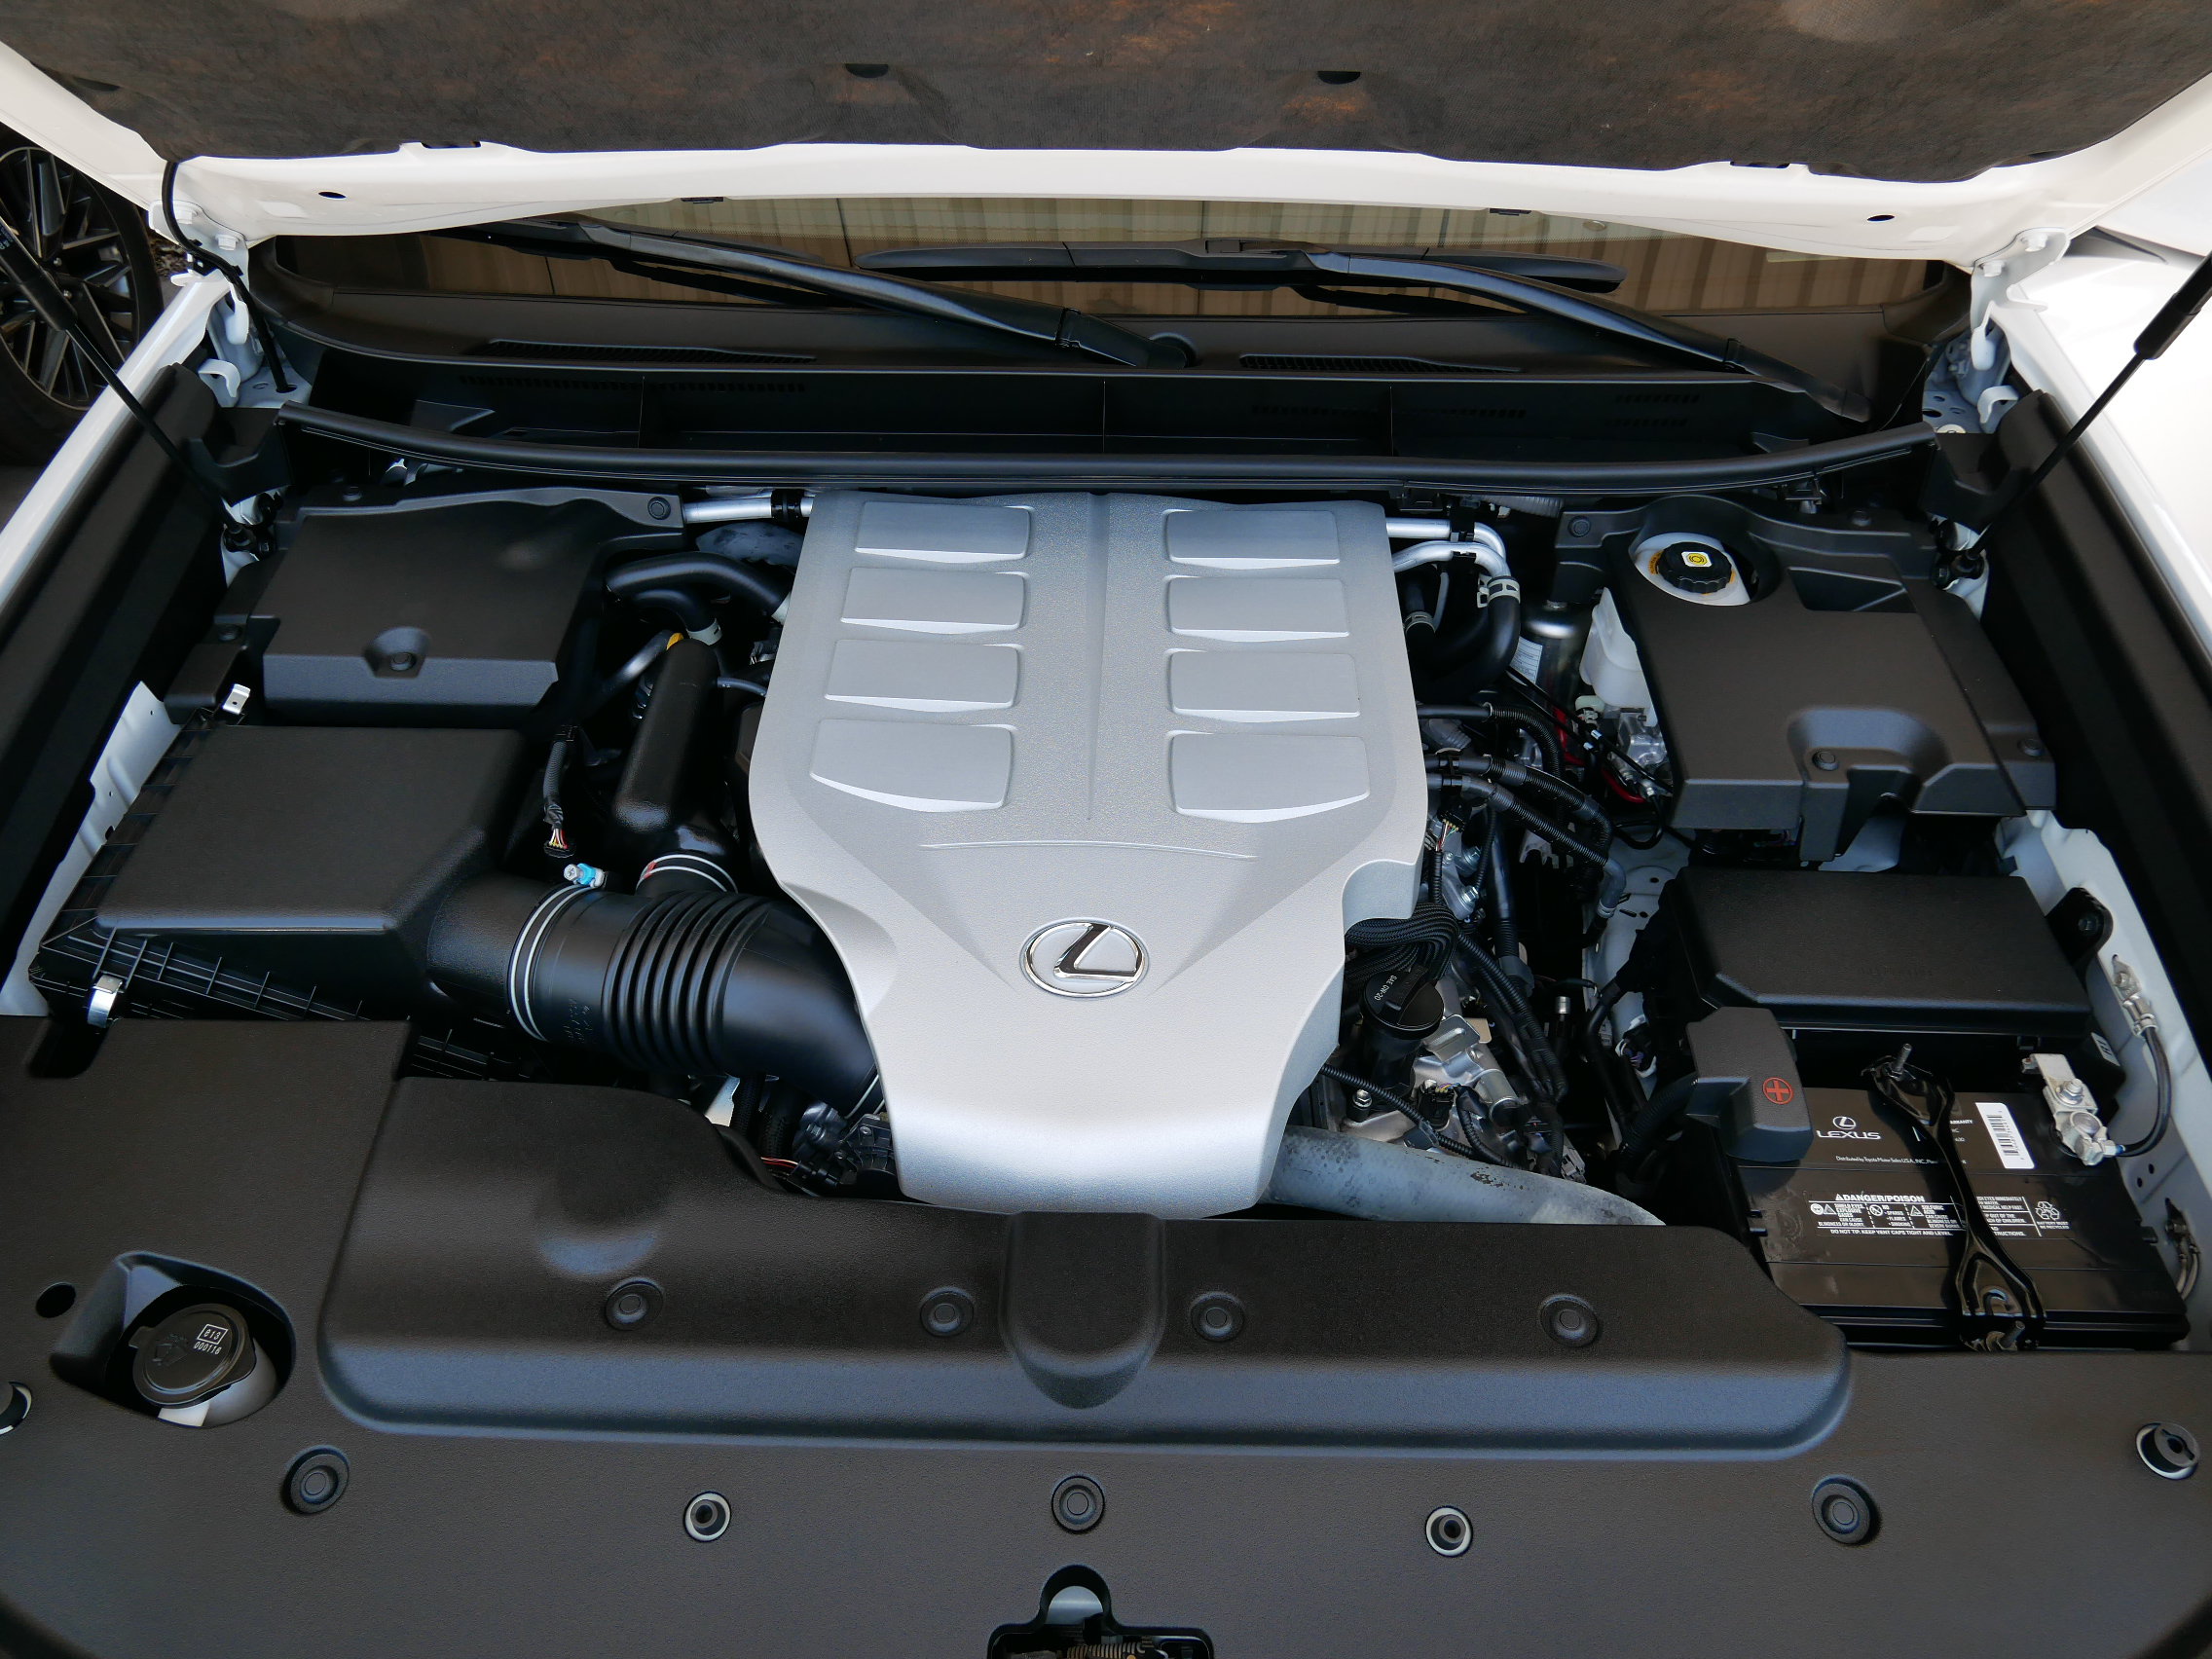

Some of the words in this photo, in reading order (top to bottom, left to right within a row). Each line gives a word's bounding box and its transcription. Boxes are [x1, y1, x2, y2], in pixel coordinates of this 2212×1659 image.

[1385, 975, 1398, 985] SAE
[1816, 1129, 1882, 1140] LEXUS
[1842, 1194, 1926, 1202] DANGER/POISON
[203, 1328, 221, 1341] e13
